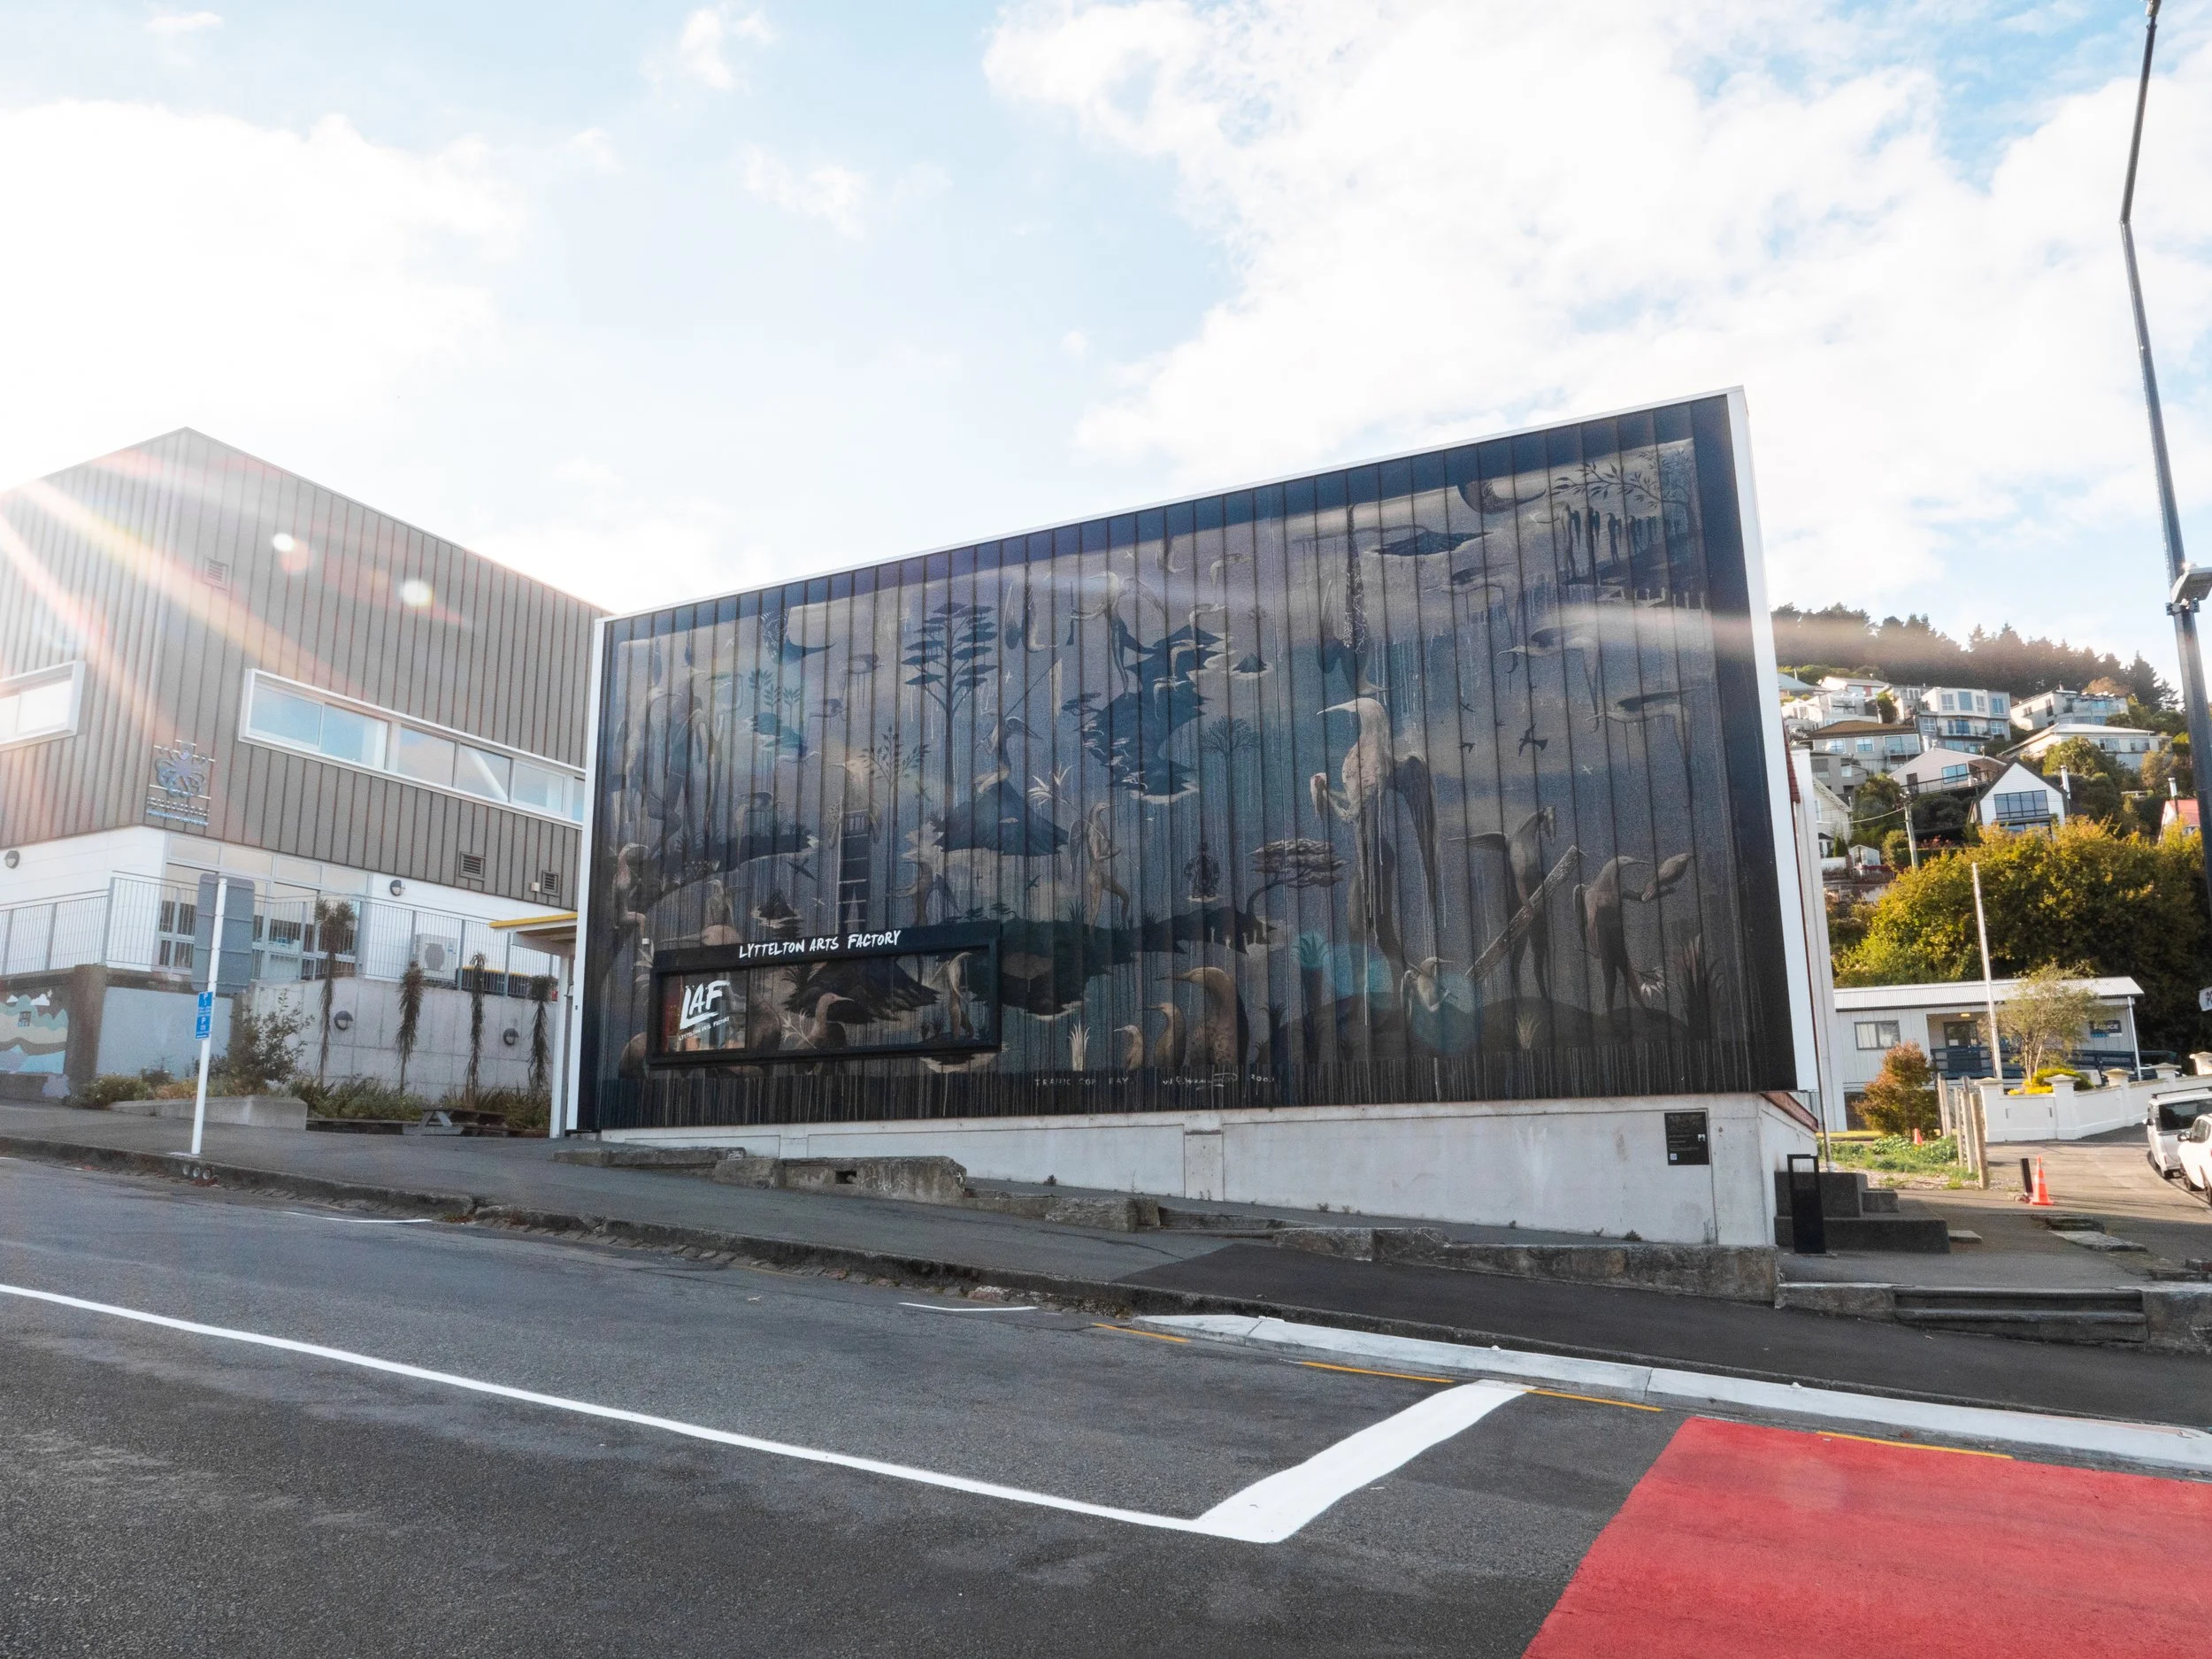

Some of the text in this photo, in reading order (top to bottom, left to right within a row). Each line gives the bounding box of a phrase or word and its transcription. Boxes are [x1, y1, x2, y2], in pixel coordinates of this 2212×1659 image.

[739, 930, 901, 959] LYTTELTON ARTS FACTORY
[680, 979, 731, 1030] LAF
